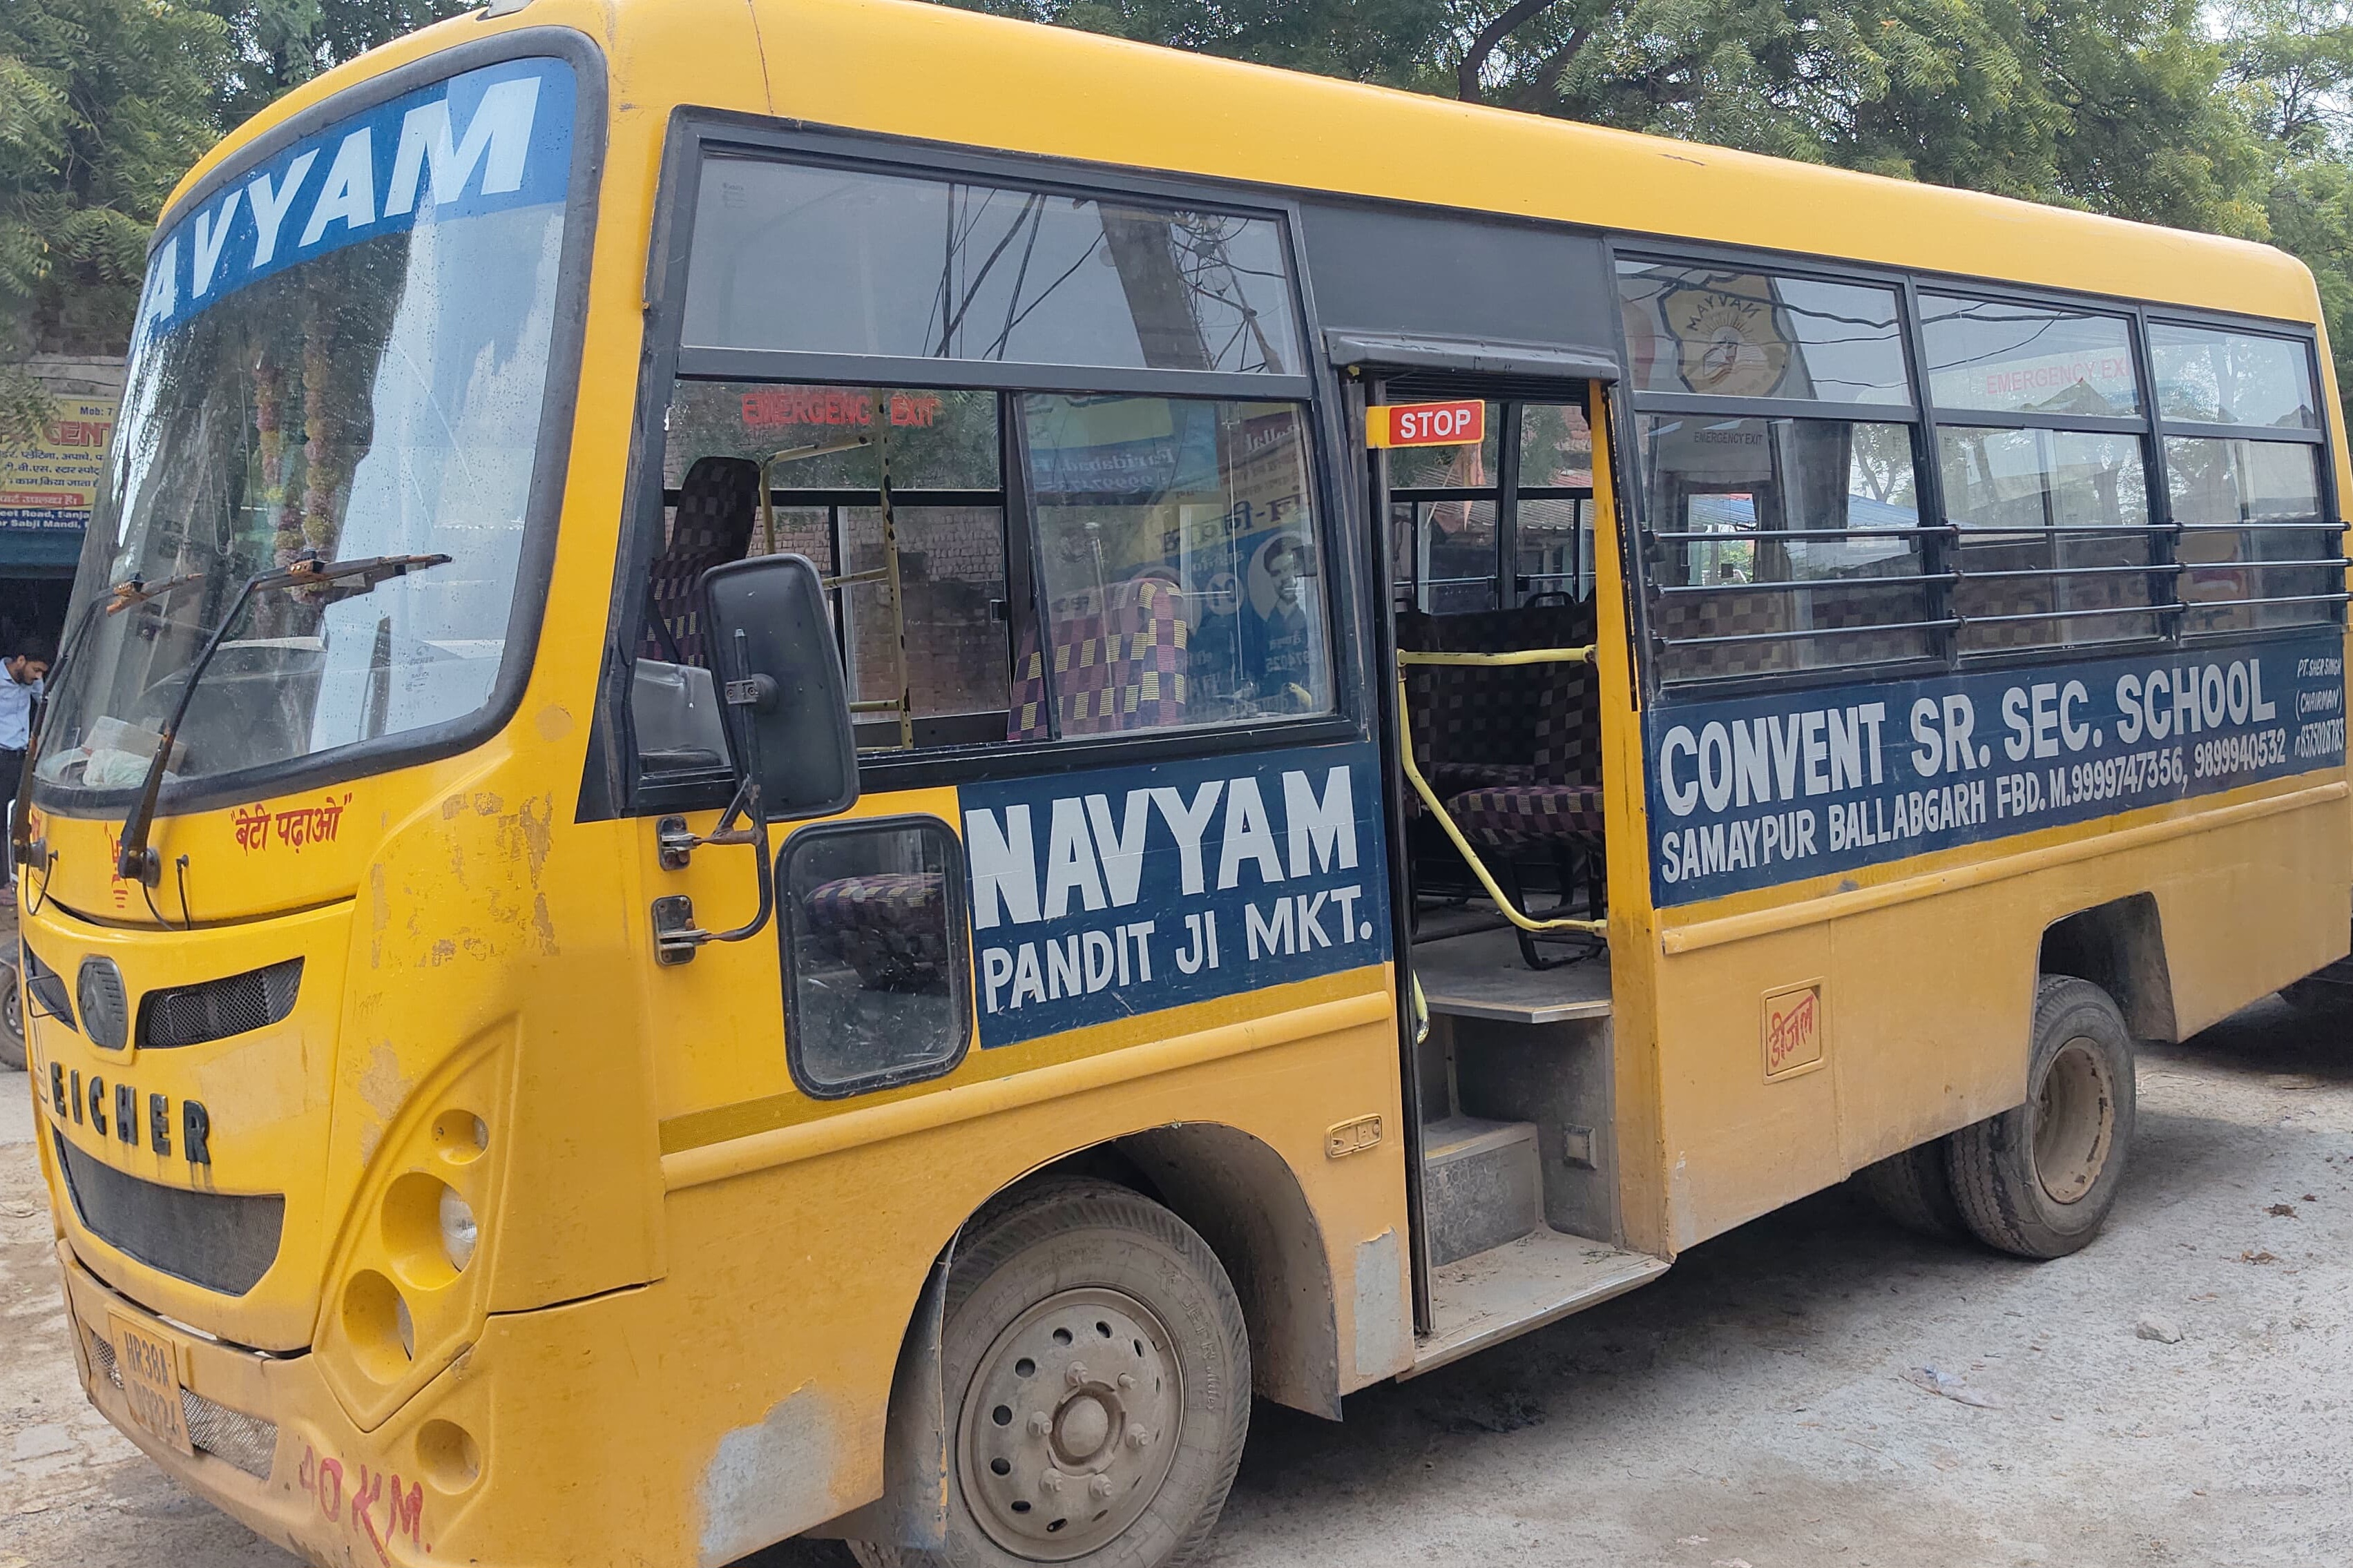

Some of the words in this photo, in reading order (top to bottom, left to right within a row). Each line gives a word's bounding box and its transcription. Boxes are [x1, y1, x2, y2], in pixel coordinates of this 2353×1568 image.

[146, 76, 541, 323] AVYAM
[1986, 360, 2097, 396] EMERGENCY
[2100, 357, 2130, 380] EXI
[79, 406, 104, 416] Mob:
[741, 391, 874, 427] EMERGENC
[890, 397, 938, 427] EXIT
[1400, 409, 1471, 439] STOP
[1693, 432, 1744, 443] EMERGENCY
[1745, 433, 1763, 445] EXIT
[11, 519, 41, 530] Sabji
[44, 521, 81, 530] Mandi,
[22, 510, 55, 519] Road,
[1660, 701, 1886, 817] CONVENT
[1910, 693, 1990, 777] SR.
[2002, 679, 2103, 762] SEC.
[2115, 658, 2276, 744] SCHOOL
[1662, 809, 1818, 884] SAMAYPUR
[1829, 779, 1986, 853] BALLABGARH
[1997, 771, 2046, 819] FBD.
[2194, 728, 2287, 779] 9899940532
[966, 765, 1358, 930] NAVYAM
[983, 920, 1155, 1014] PANDIT
[1175, 910, 1220, 974] JI
[1245, 884, 1373, 961] MKT.
[50, 1061, 212, 1165] EICHER
